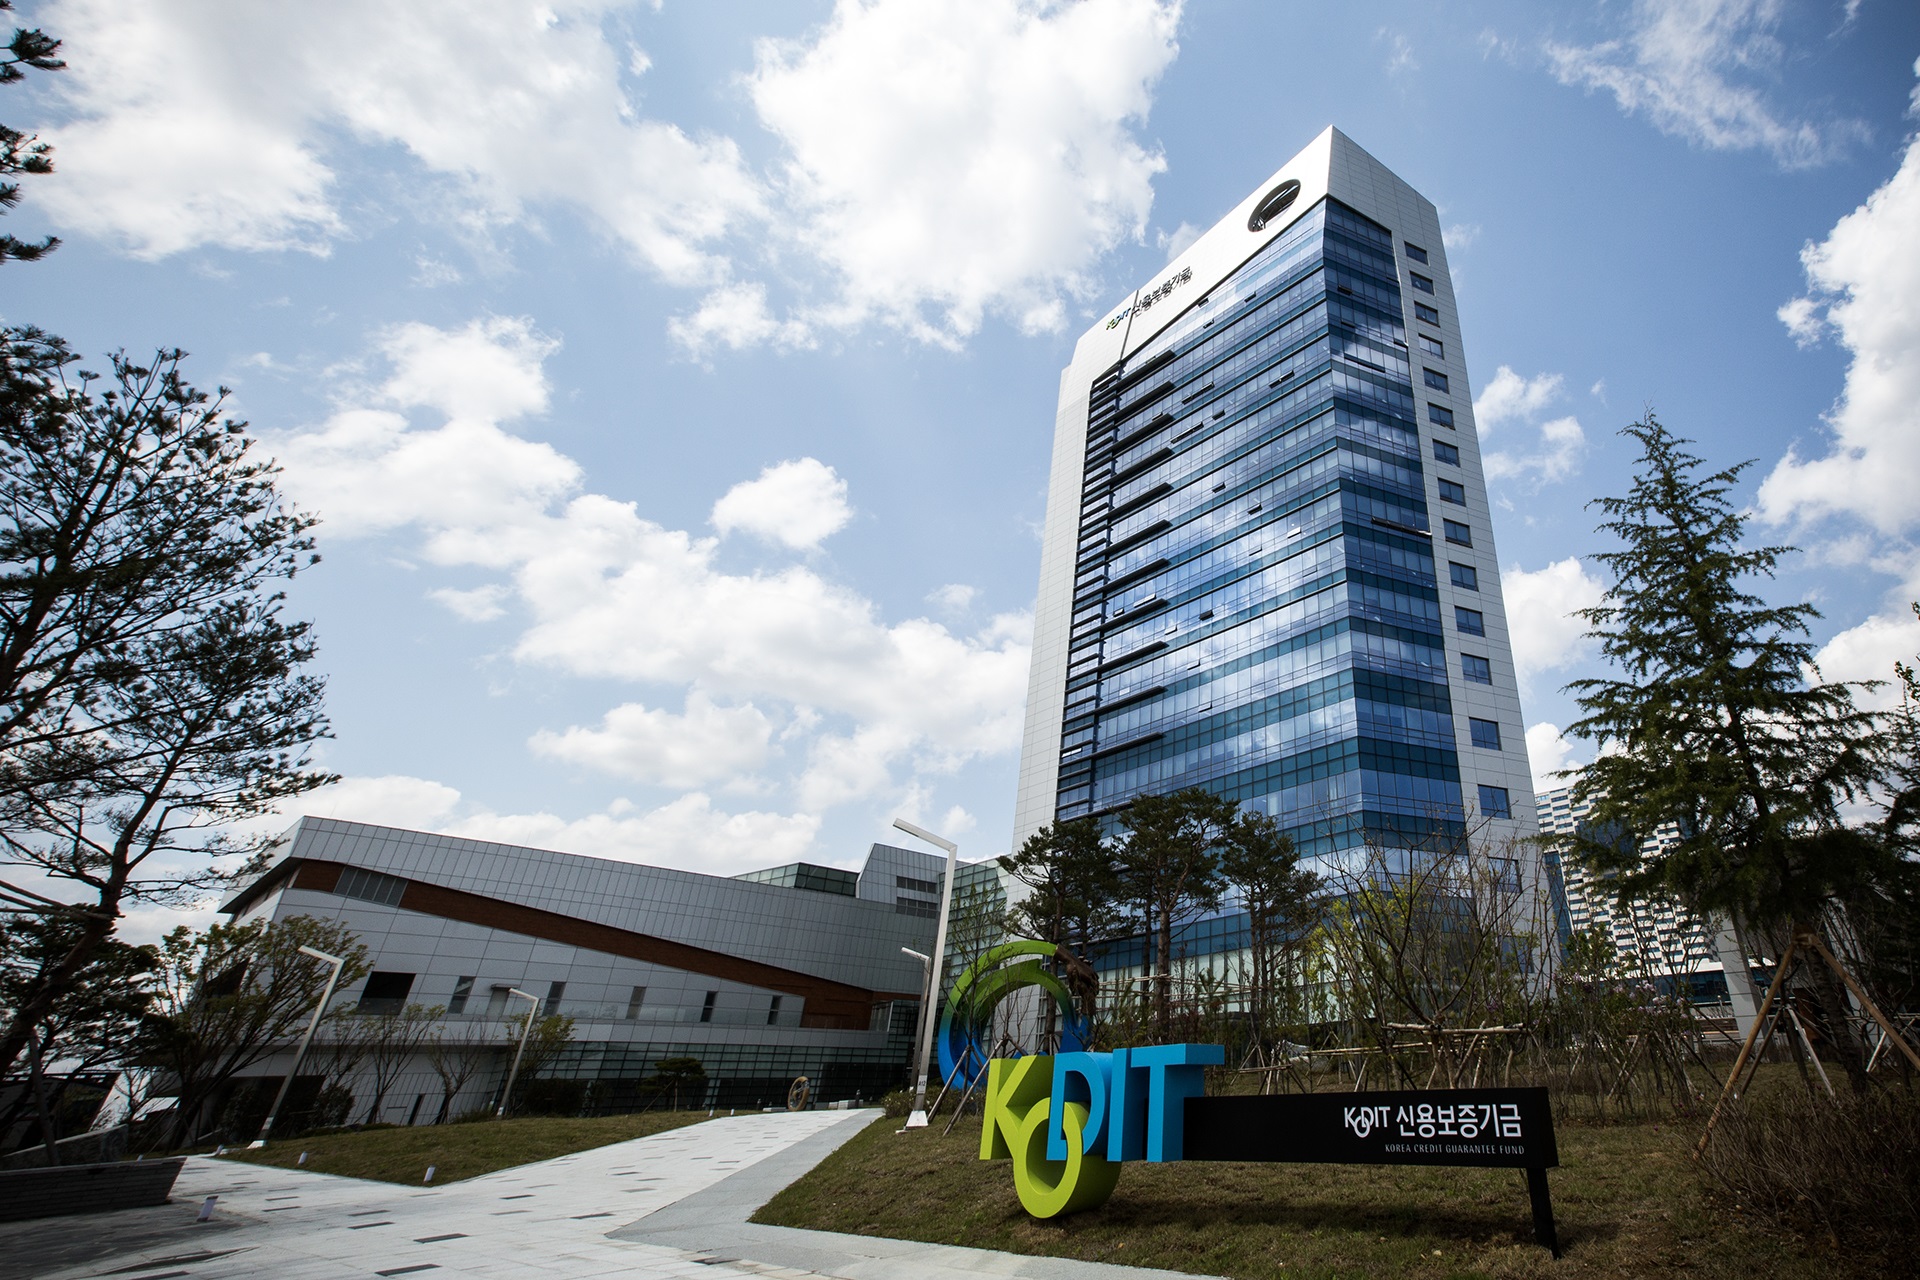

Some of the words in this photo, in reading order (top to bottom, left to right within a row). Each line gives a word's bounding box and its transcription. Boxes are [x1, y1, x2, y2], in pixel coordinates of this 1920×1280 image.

[979, 1043, 1224, 1219] KODIT
[1344, 1106, 1391, 1138] KODIT
[1395, 1104, 1522, 1138] 신용보증기금
[1385, 1143, 1412, 1153] KOREA
[1413, 1143, 1443, 1153] CREDIT
[1445, 1144, 1496, 1154] GUARANTEE
[1499, 1145, 1525, 1155] FUND
